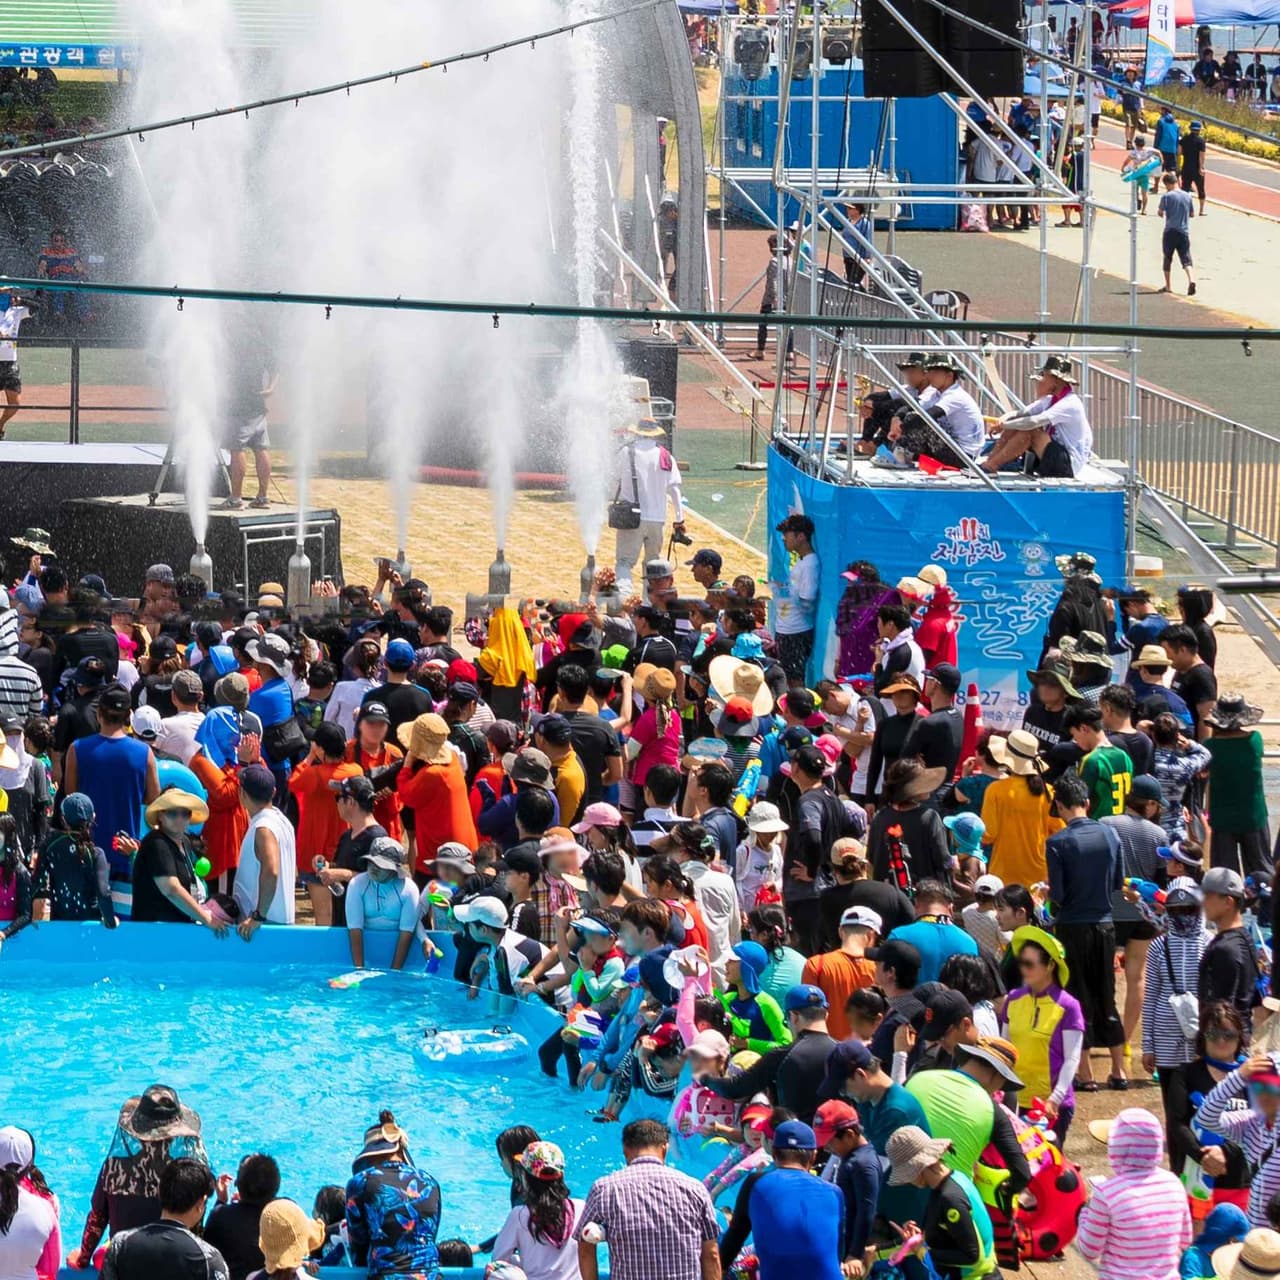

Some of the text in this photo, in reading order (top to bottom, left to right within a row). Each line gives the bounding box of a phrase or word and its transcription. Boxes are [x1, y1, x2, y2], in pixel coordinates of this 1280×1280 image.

[19, 46, 85, 65] 관광객
[944, 516, 991, 541] 제11회
[930, 540, 1007, 566] 정남진
[980, 691, 1001, 706] 27
